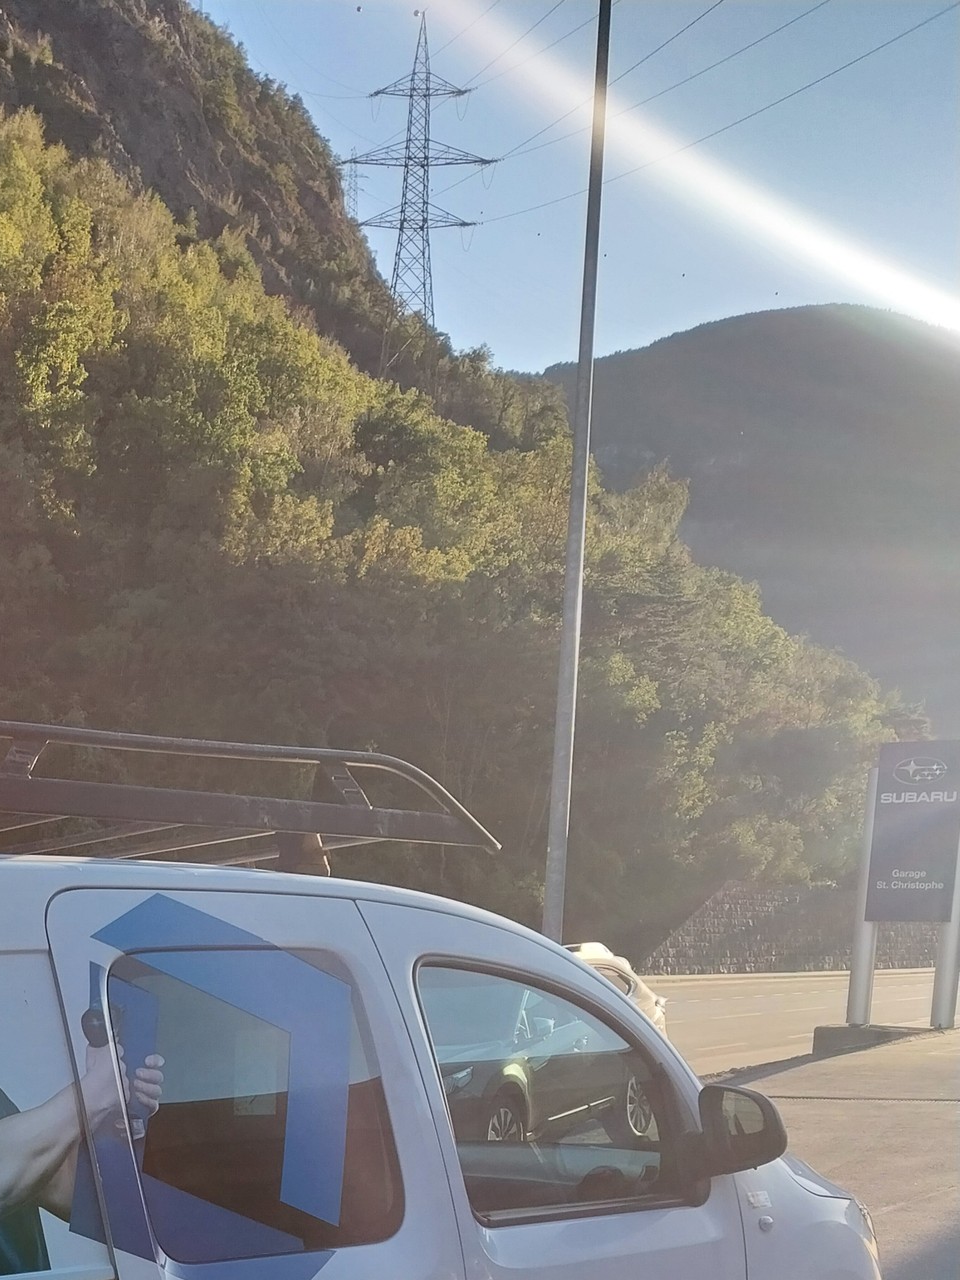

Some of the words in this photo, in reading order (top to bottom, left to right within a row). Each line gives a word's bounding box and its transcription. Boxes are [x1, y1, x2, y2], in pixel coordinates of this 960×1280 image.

[880, 791, 958, 804] SUBARU
[891, 868, 927, 879] Garage
[876, 880, 889, 889] St.
